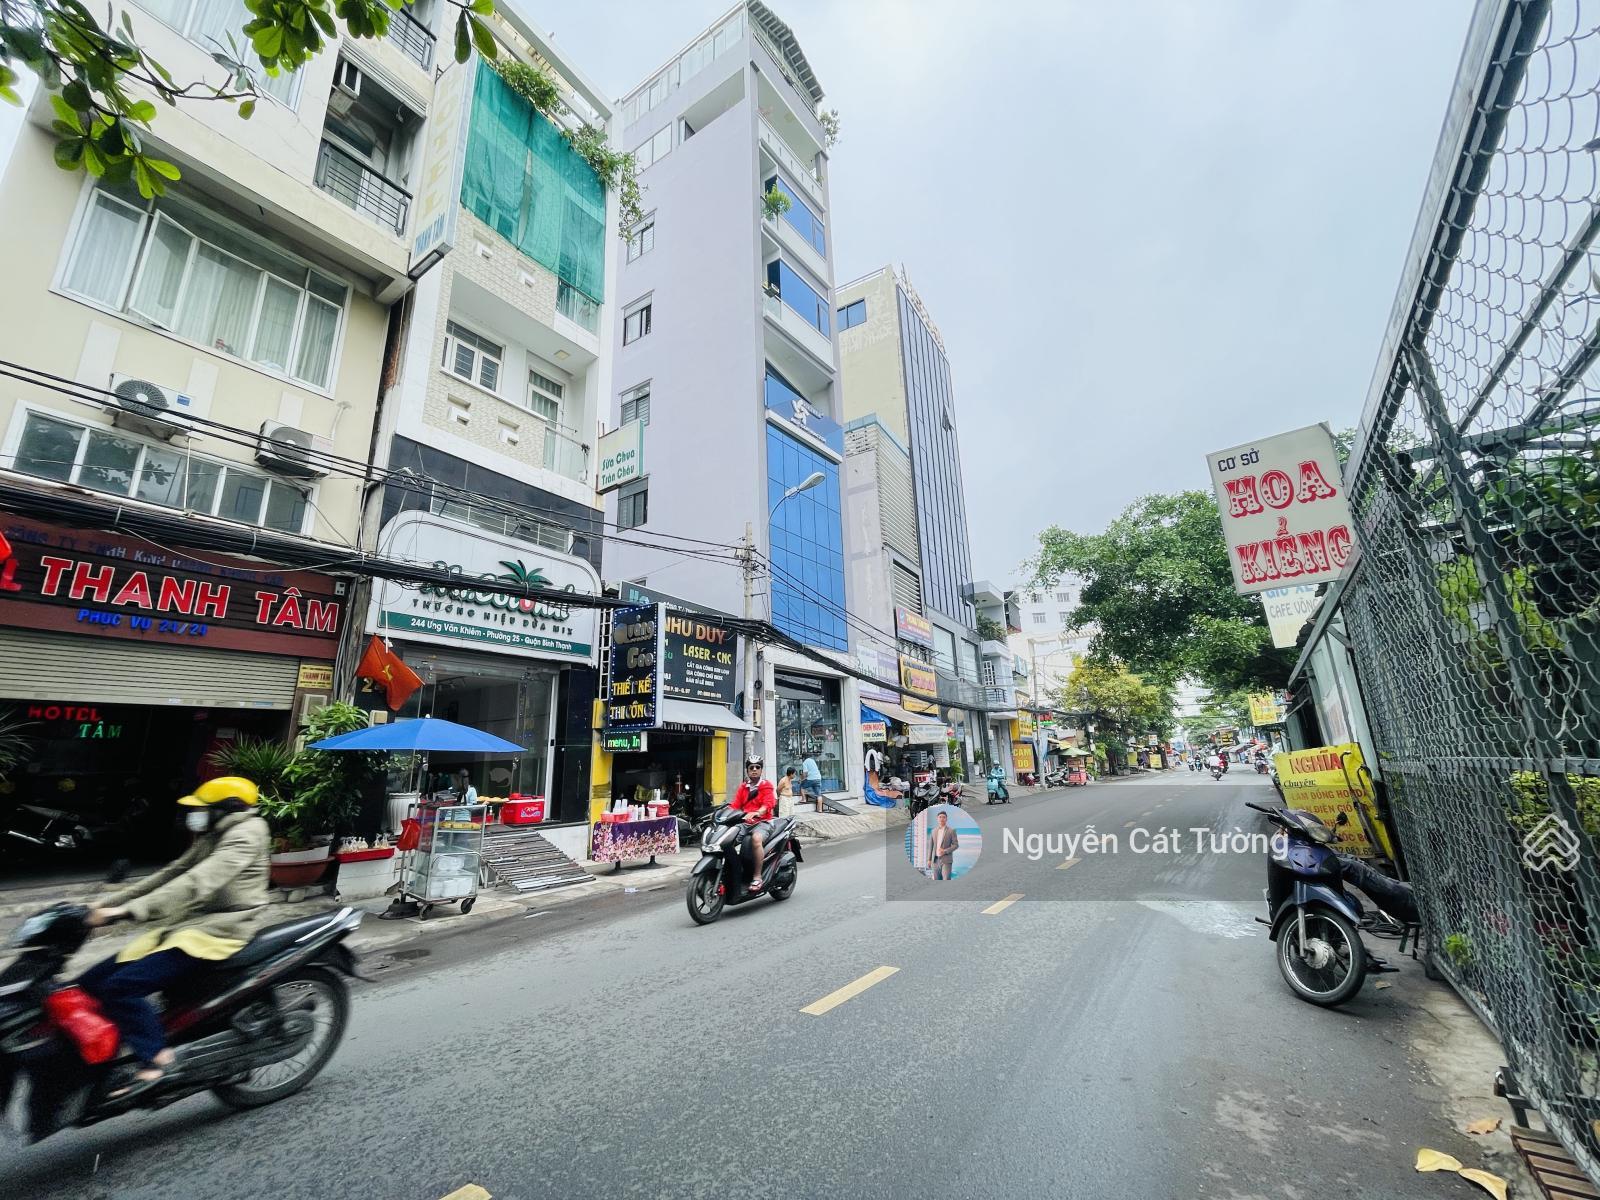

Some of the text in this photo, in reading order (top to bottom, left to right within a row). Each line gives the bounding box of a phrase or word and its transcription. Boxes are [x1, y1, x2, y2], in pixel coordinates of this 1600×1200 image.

[1241, 447, 1261, 466] SỞ
[1223, 461, 1337, 518] HOA
[40, 555, 340, 633] THANH TÂM
[1269, 602, 1293, 618] CAFE
[158, 619, 208, 637] 24/24
[411, 617, 425, 627] 244
[444, 623, 458, 633] Văn
[486, 630, 510, 643] Phường
[512, 634, 520, 642] 25
[525, 636, 541, 646] Quận
[552, 625, 573, 635] MIX
[696, 624, 725, 645] DUY
[683, 643, 711, 661] LASER
[27, 705, 103, 722] HOTEL
[79, 721, 123, 738] TÂM
[607, 736, 640, 749] menu, In
